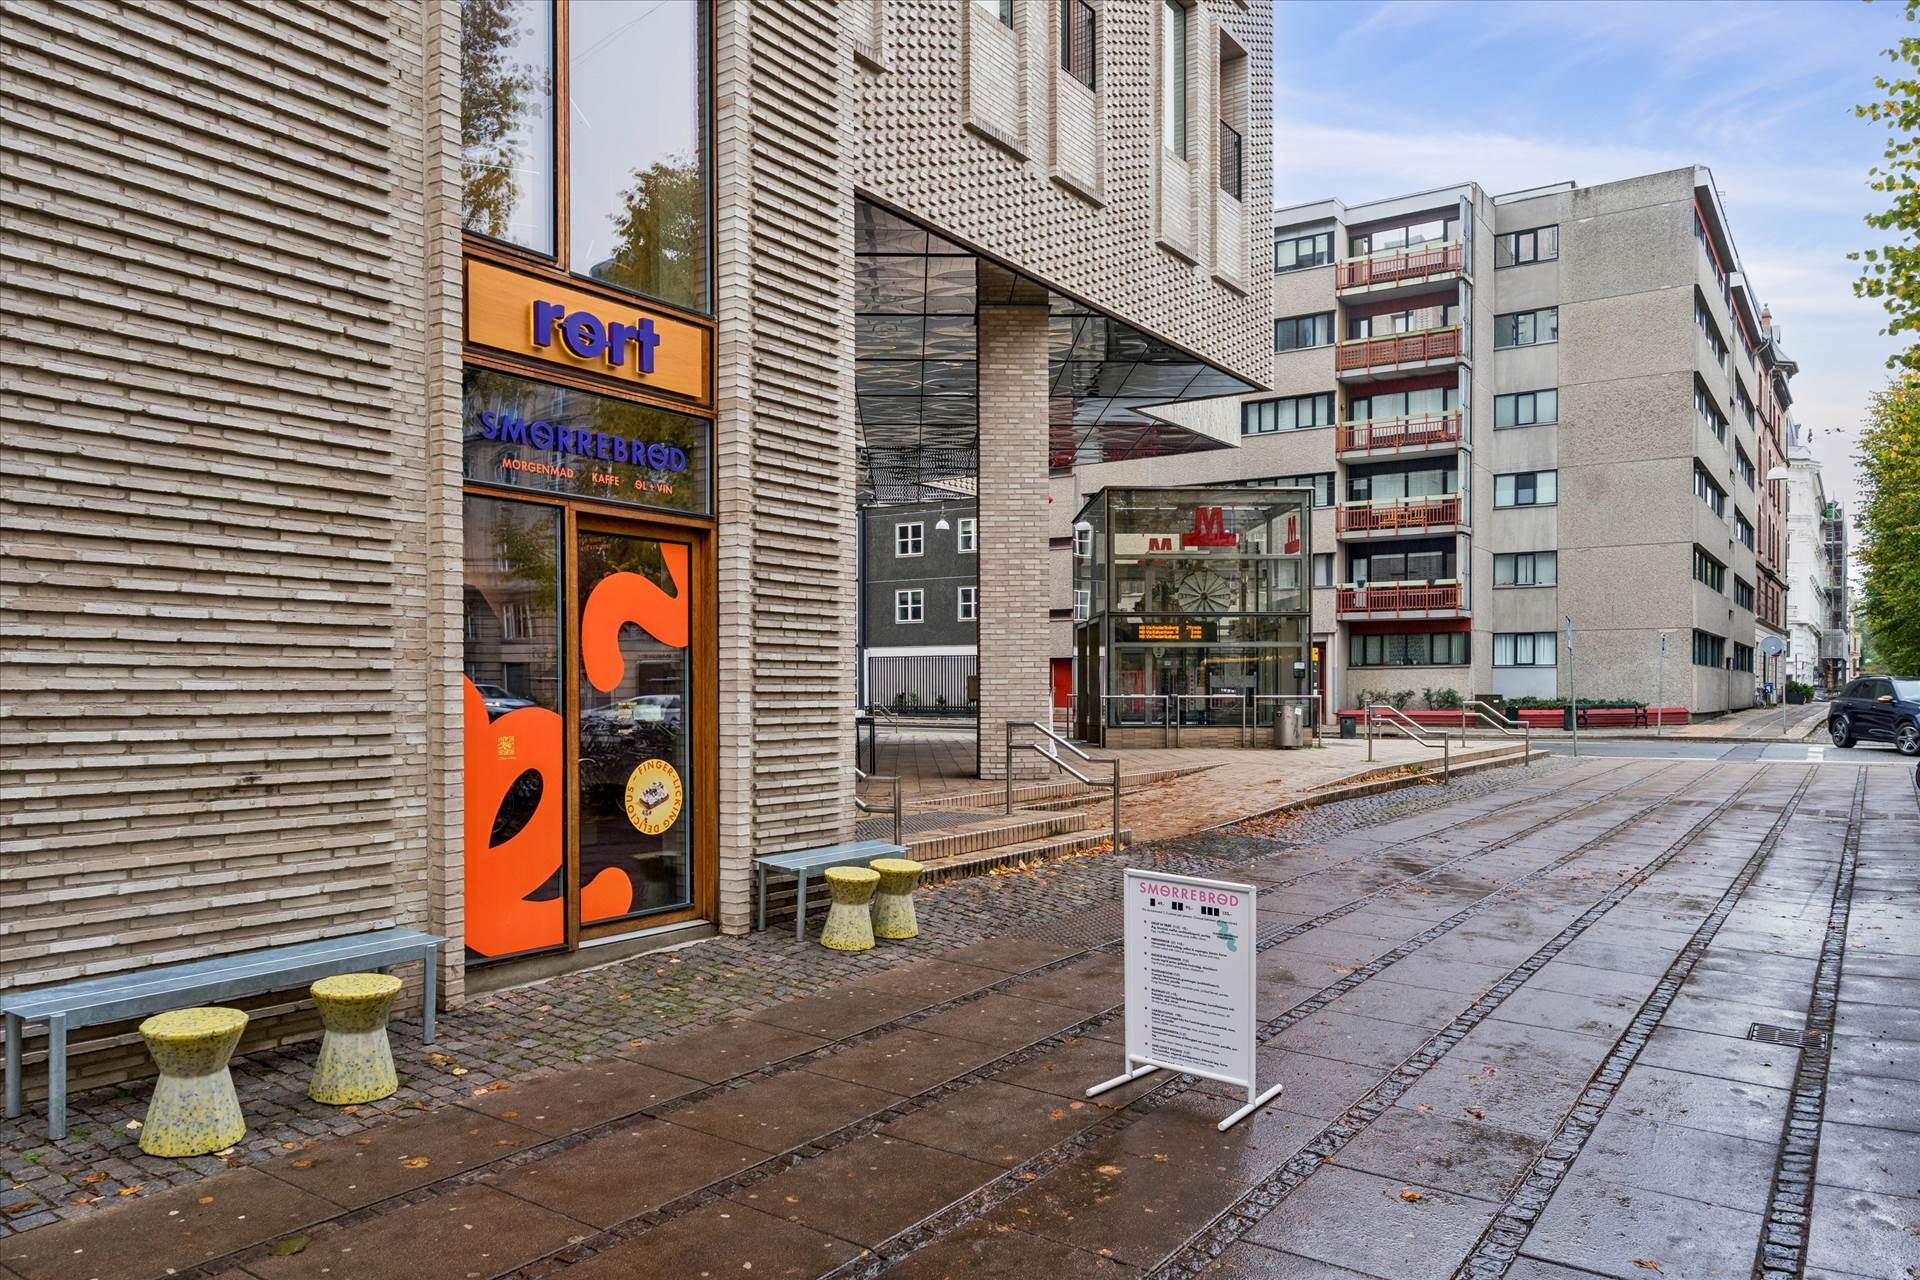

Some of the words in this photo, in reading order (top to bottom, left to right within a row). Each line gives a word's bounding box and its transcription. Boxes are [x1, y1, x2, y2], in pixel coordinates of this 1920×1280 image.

[480, 410, 687, 473] SMØRREBRØD
[502, 457, 575, 480] MORGENMAD
[591, 472, 621, 487] KAFFE
[657, 483, 674, 496] VIN
[626, 786, 660, 833] DELICIOUS
[1139, 882, 1240, 907] SMØRREBRØD
